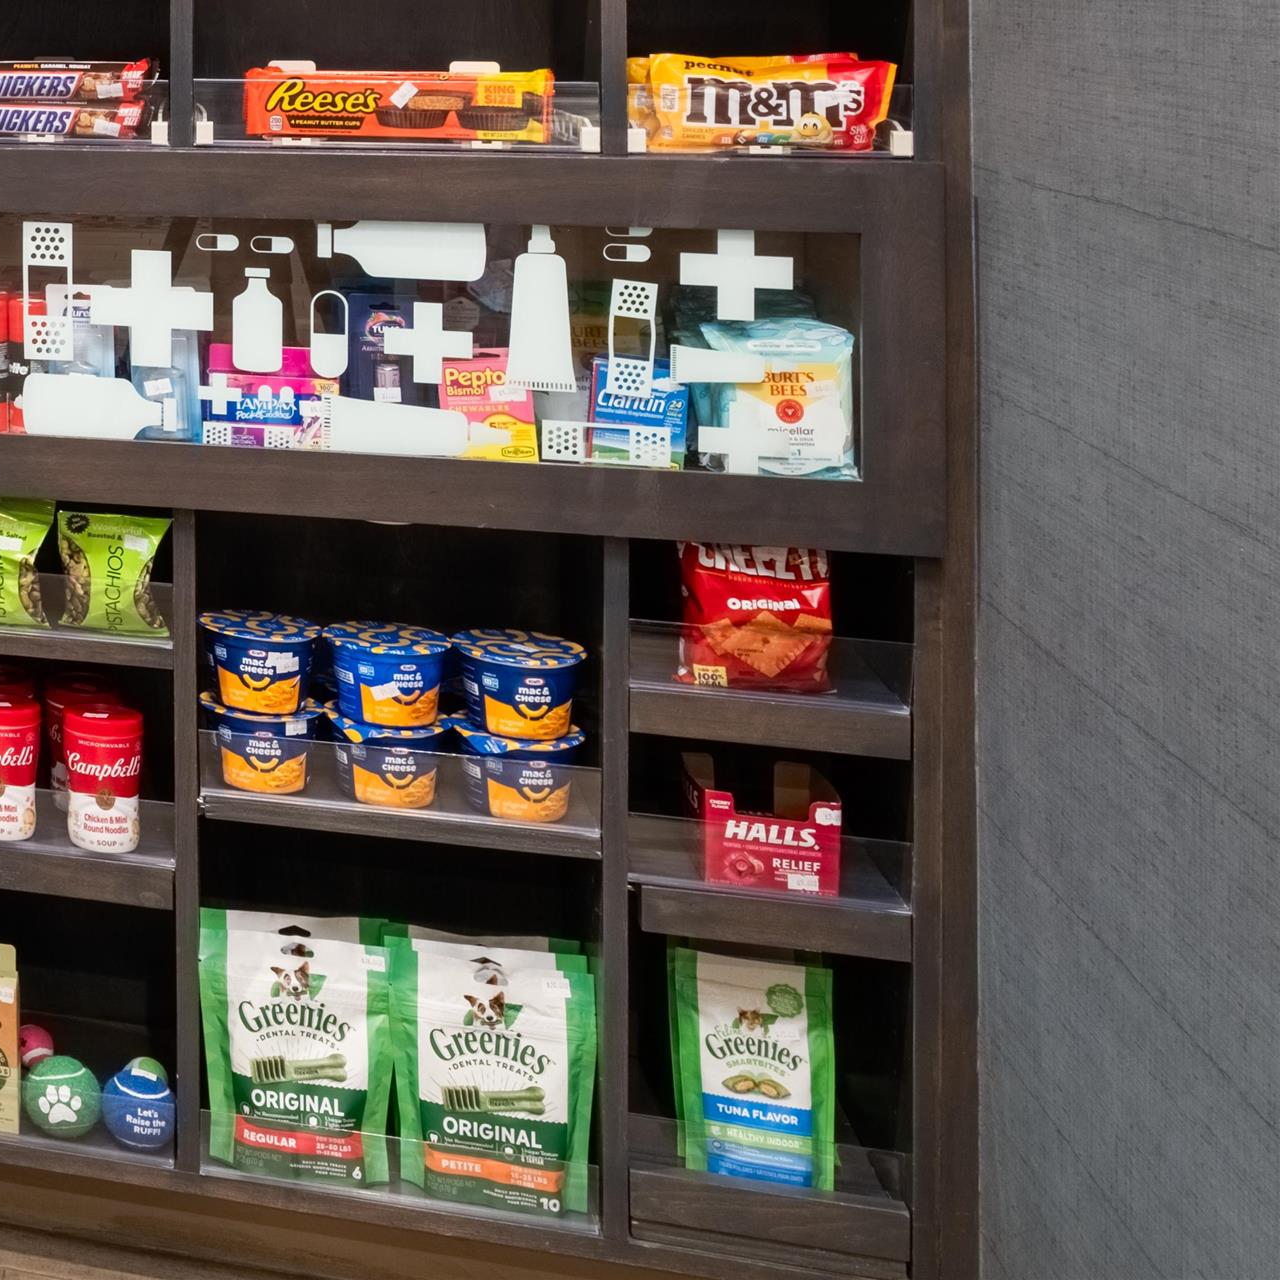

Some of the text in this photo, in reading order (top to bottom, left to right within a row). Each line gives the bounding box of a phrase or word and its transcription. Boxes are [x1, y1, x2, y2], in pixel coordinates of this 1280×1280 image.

[683, 59, 754, 77] peanut
[265, 77, 382, 114] Reese's
[483, 84, 516, 95] KING
[483, 95, 516, 105] SIZE
[444, 367, 507, 389] Pepto
[763, 371, 815, 384] BURT'S
[446, 385, 486, 397] Bismol
[770, 384, 808, 397] BEES
[596, 388, 666, 413] Claritin
[669, 400, 683, 409] 24
[87, 531, 115, 540] Roasted
[241, 656, 263, 666] mac
[393, 673, 414, 681] mac
[518, 686, 541, 695] mac
[77, 739, 131, 749] MICROWAVABLE
[248, 739, 271, 748] mac
[66, 750, 141, 781] Campbell's
[385, 756, 406, 764] mac
[522, 770, 544, 778] mac
[3, 803, 18, 813] Mini
[83, 813, 128, 824] Chicken Mini
[83, 823, 129, 835] Round Noodles
[724, 819, 820, 850] HALLS
[96, 839, 118, 848] SOUP
[772, 857, 822, 872] RELIEF
[238, 999, 353, 1043] Greenies
[259, 1029, 337, 1050] DENTAL TREATS
[428, 1027, 553, 1075] Greenies
[704, 1032, 804, 1072] Greenies
[451, 1058, 535, 1084] DENTAL TREATS
[250, 1087, 345, 1117] ORIGINAL
[137, 1107, 159, 1118] Let's
[716, 1102, 799, 1126] TUNA FLAVOR
[126, 1113, 166, 1128] Raise the
[133, 1125, 161, 1136] RUFF!
[442, 1115, 543, 1149] ORIGINAL
[243, 1128, 297, 1149] REGULAR
[441, 1157, 482, 1173] PETITE
[351, 1165, 363, 1180] 6
[539, 1196, 561, 1213] 10
